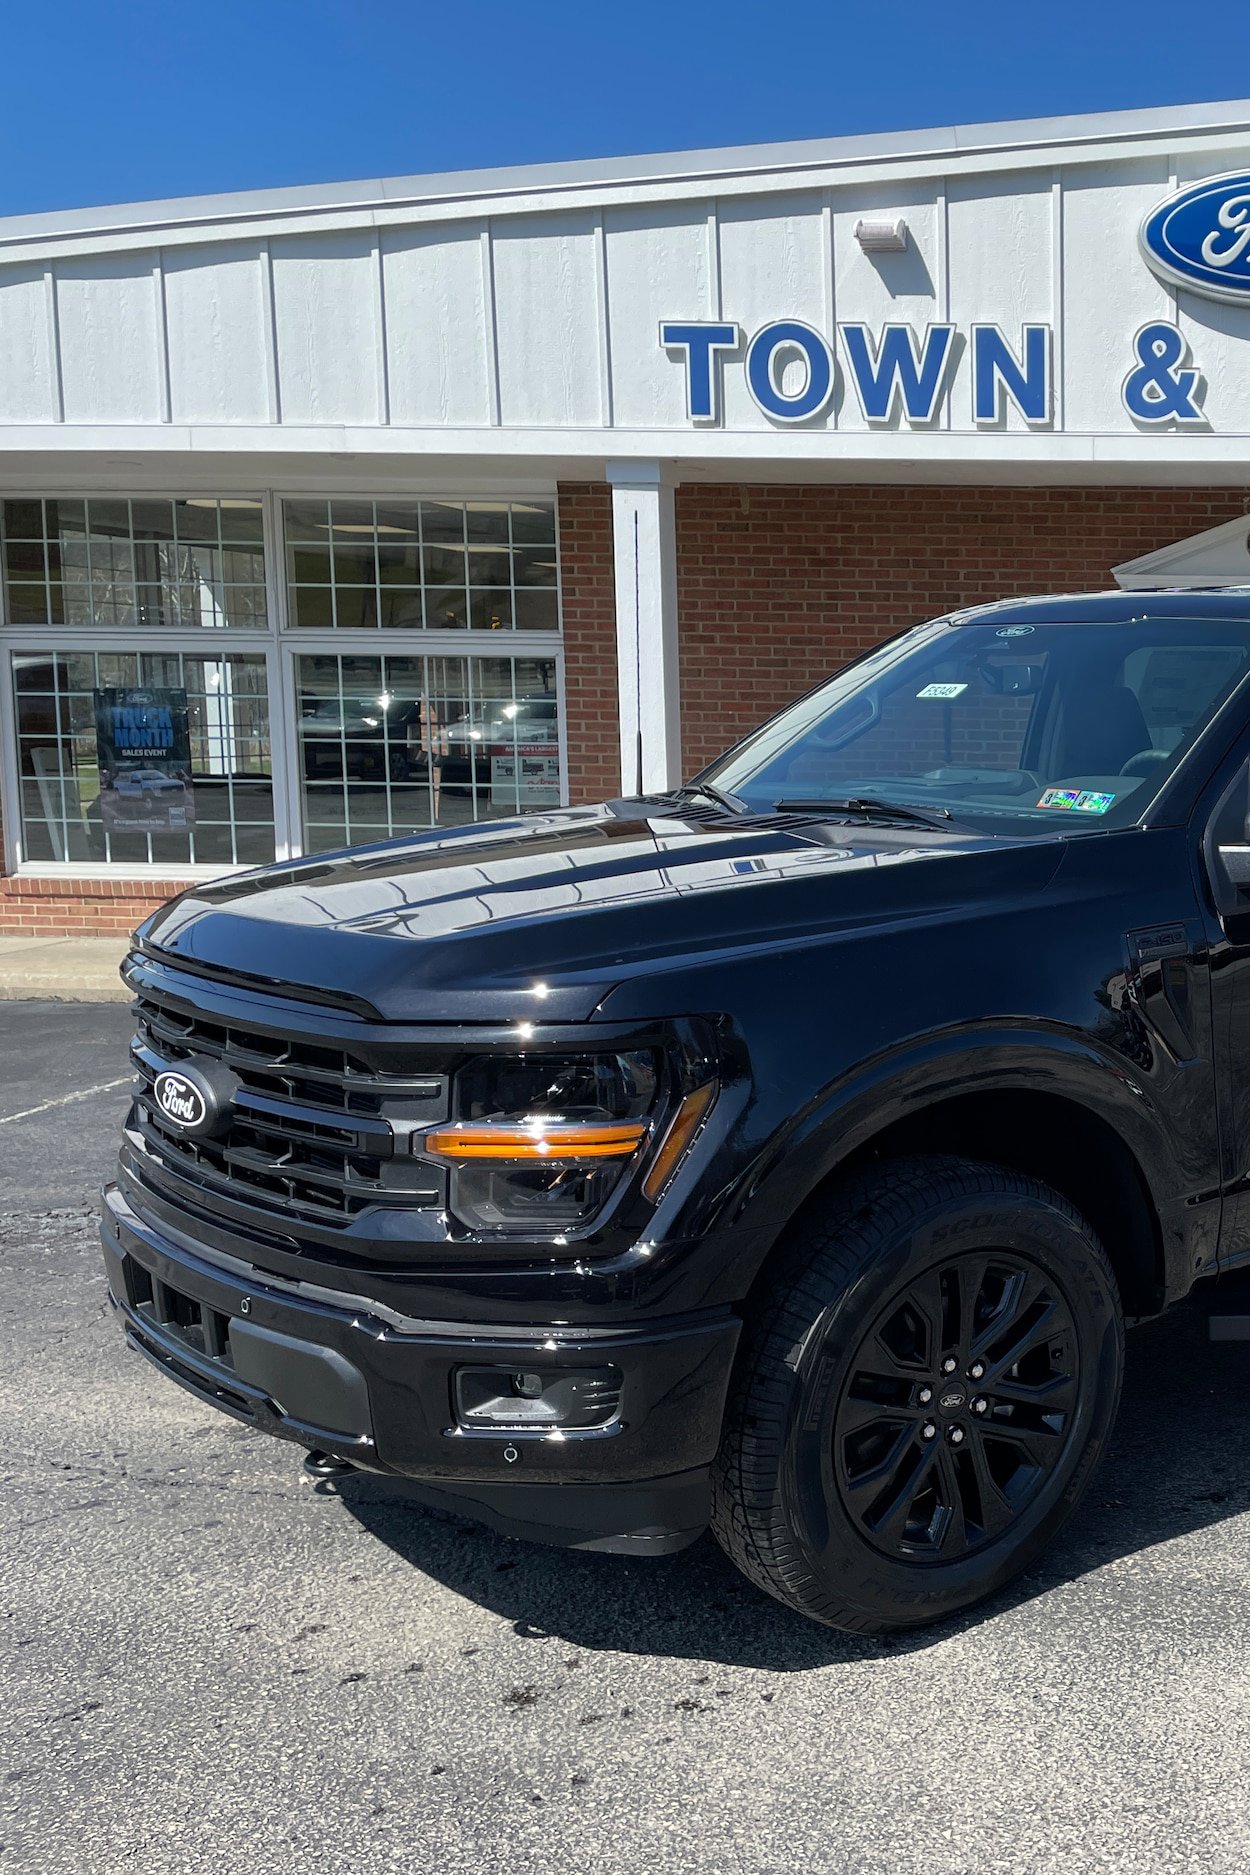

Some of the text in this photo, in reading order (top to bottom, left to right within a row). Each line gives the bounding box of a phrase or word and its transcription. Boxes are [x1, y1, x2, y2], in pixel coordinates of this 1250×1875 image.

[659, 319, 1053, 424] TOWN
[1120, 319, 1207, 424] &
[111, 706, 172, 728] TRUCK
[114, 728, 174, 748] MONTH
[121, 749, 168, 757] SALES EVENT
[162, 1077, 194, 1120] Ford
